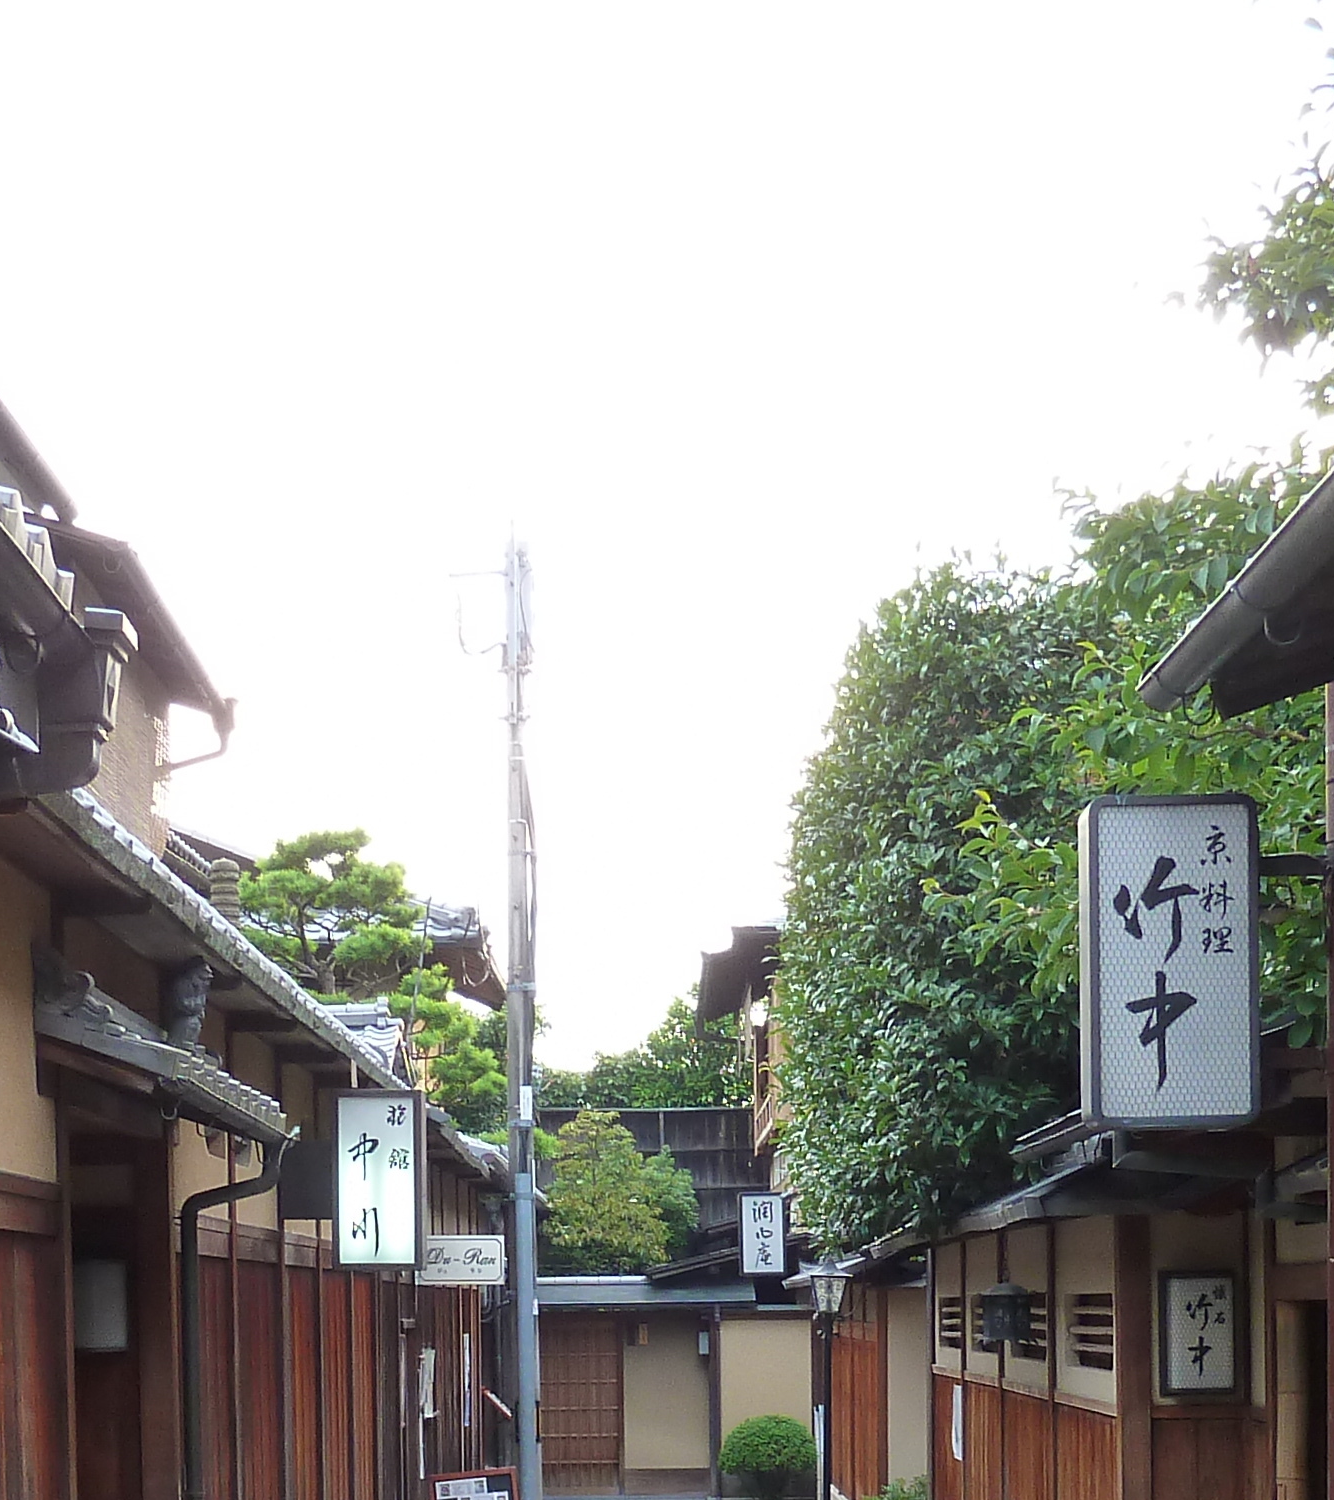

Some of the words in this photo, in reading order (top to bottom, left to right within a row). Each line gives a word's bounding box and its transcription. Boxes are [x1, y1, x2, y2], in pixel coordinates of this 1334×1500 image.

[1199, 824, 1235, 954] 京料理
[1113, 855, 1200, 1093] 竹中
[348, 1132, 379, 1257] 中川
[1187, 1293, 1213, 1378] 竹中
